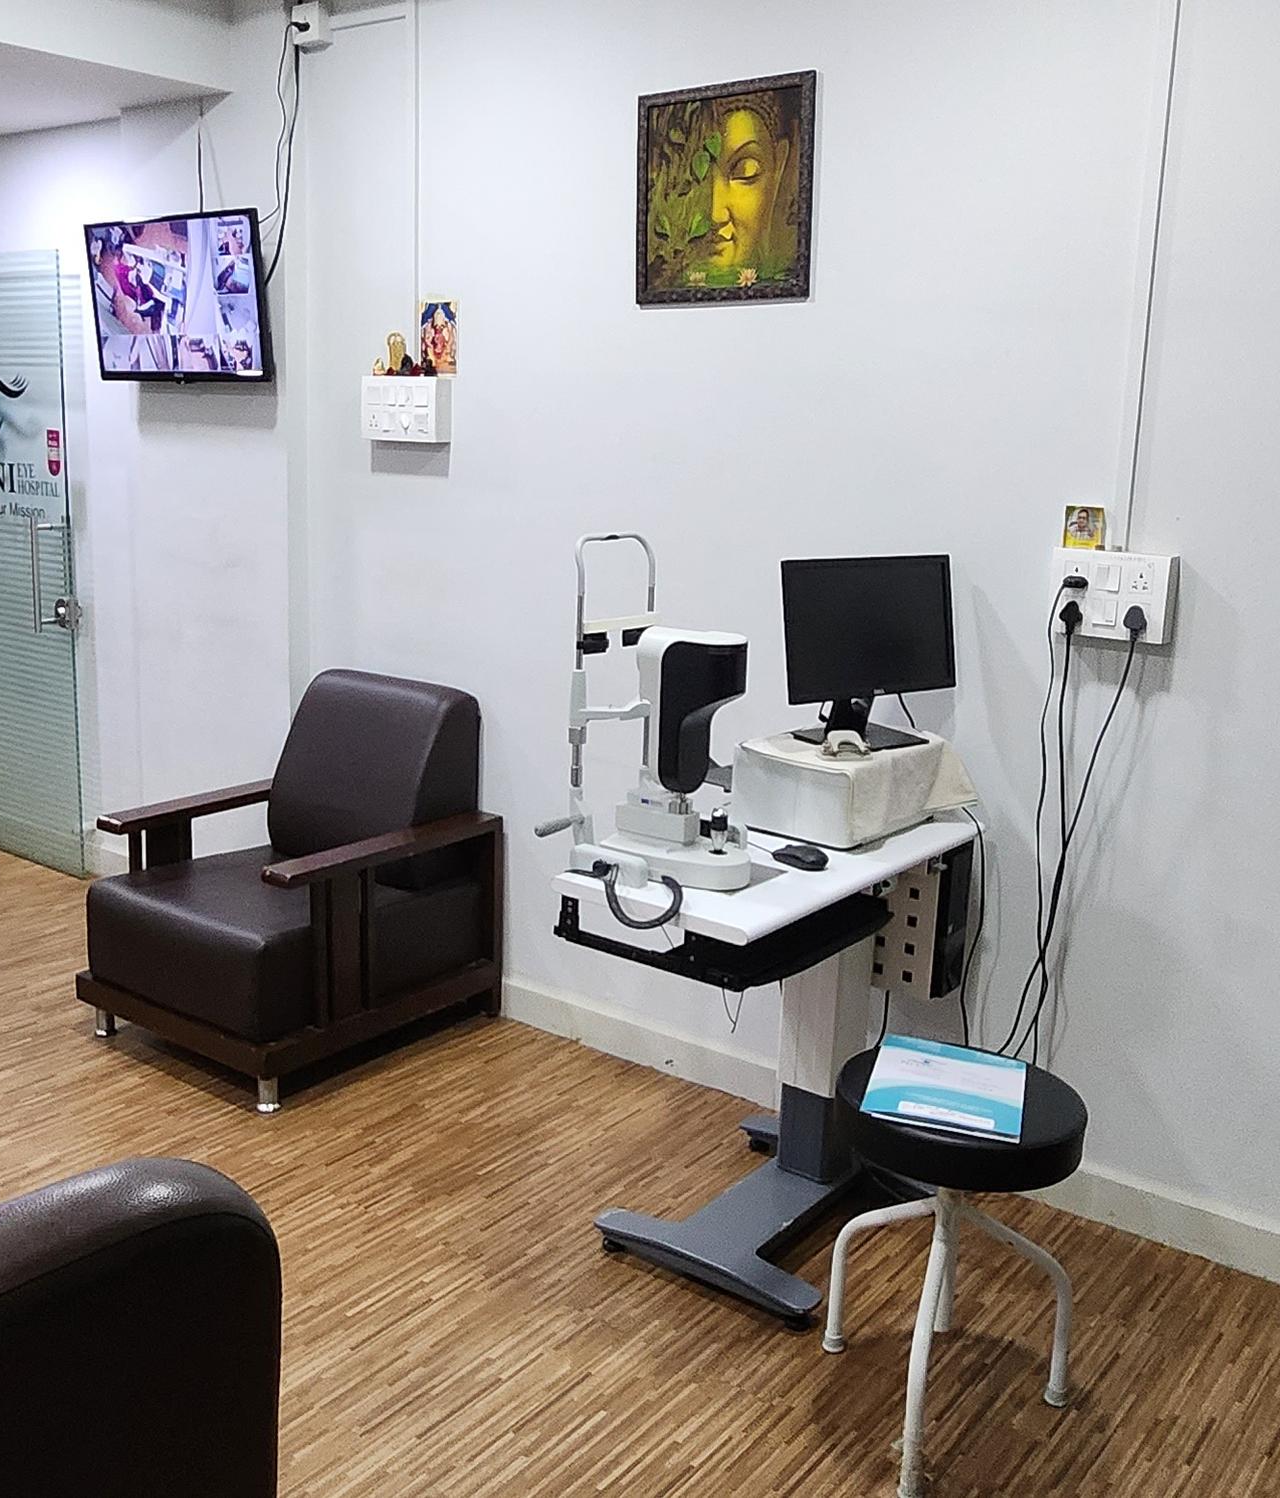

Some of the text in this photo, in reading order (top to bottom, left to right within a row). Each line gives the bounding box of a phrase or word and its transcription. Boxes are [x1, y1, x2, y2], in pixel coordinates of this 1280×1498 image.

[17, 462, 36, 479] EYE
[17, 480, 60, 498] HOSPITAL
[9, 501, 46, 519] Mission
